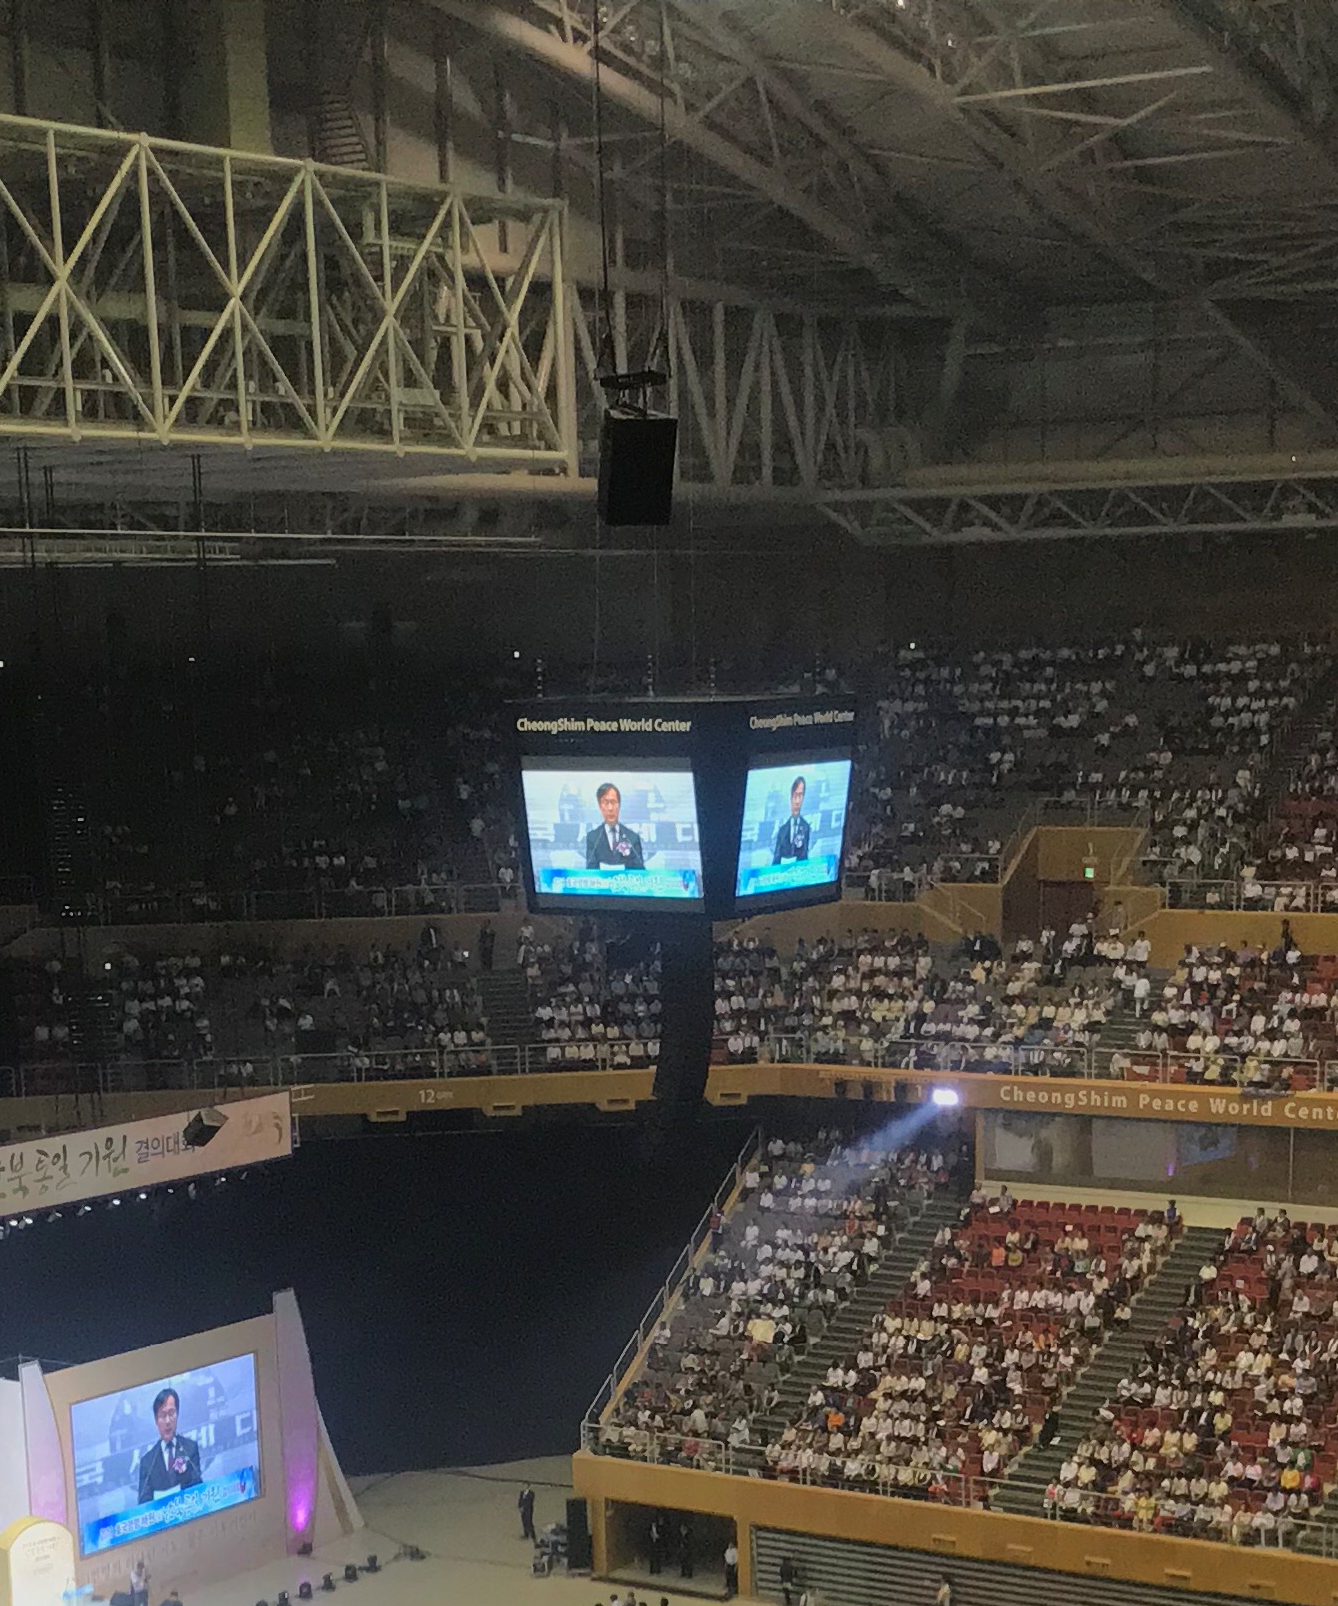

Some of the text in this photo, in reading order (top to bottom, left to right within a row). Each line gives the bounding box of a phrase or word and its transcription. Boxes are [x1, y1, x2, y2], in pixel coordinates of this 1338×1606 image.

[517, 717, 691, 734] CheongShim Peace World Center
[418, 1088, 436, 1104] 12
[1000, 1085, 1127, 1109] CheongShim
[1139, 1093, 1199, 1113] Peace
[1210, 1098, 1273, 1117] World
[78, 1134, 130, 1178] 기원
